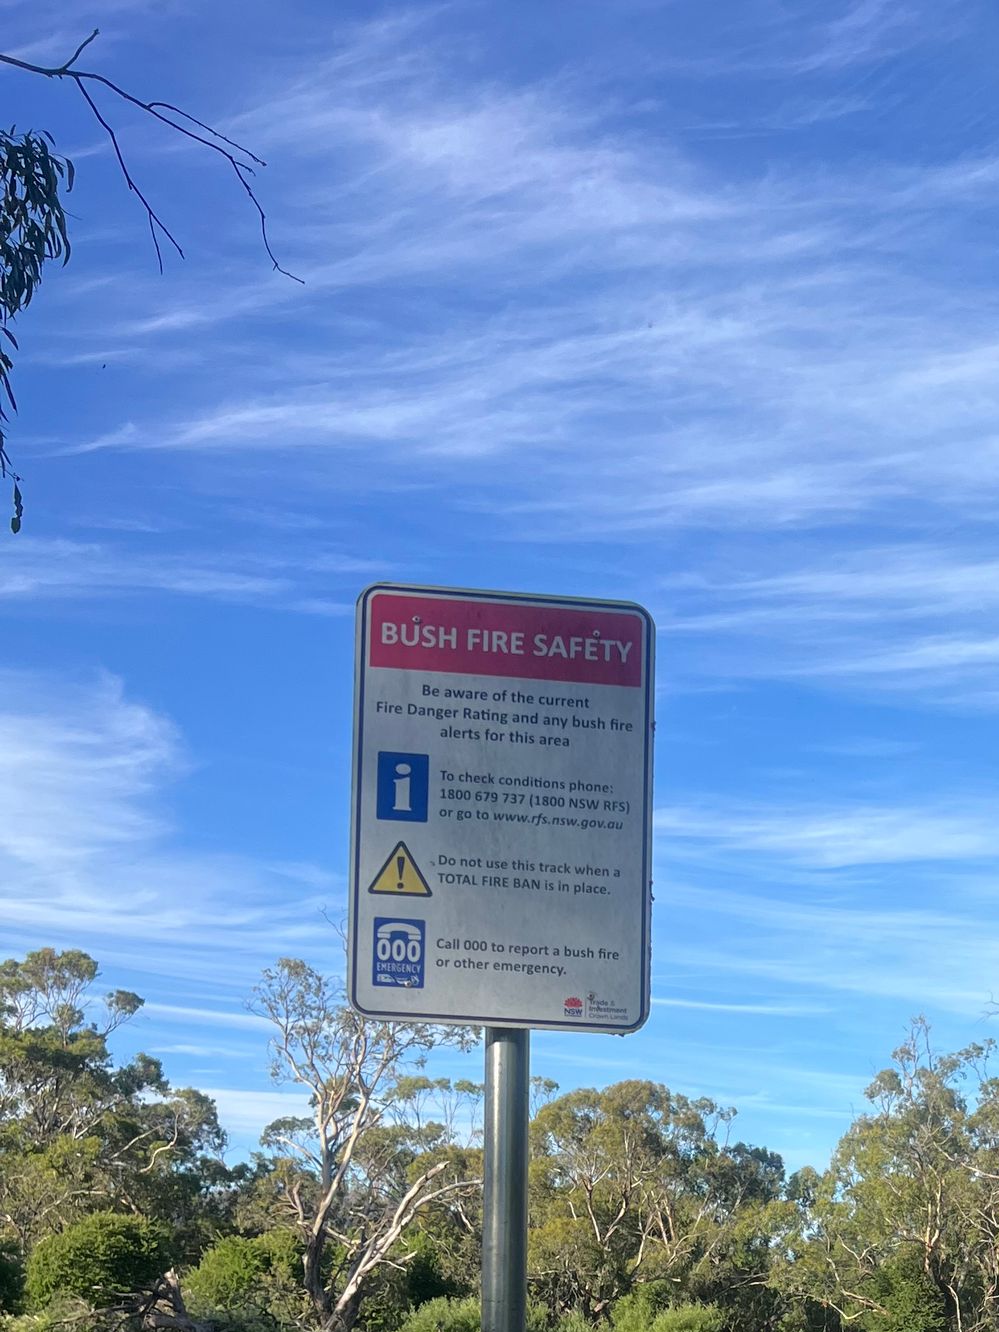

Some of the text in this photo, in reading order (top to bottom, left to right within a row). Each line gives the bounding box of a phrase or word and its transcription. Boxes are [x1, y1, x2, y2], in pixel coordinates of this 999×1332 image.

[381, 622, 632, 663] BUSH FIRE SAFETY
[422, 684, 590, 708] Be aware of the current
[376, 701, 633, 732] Fire Danger Rating and any bush fire
[440, 727, 570, 747] alerts for this area
[440, 771, 613, 794] To check conditions phone:
[440, 789, 630, 814] 1800 679 737 (1800 NSW RFS)
[440, 809, 623, 830] or go to www.rfs.nsw.gov.au
[438, 855, 620, 878] Do not use this track when a
[438, 873, 611, 895] TOTAL FIRE BAN is in place.
[377, 939, 421, 962] 000
[436, 939, 619, 960] Call 000 to report a bush fire
[377, 962, 421, 974] EMERGENCY
[436, 958, 566, 976] or other emergency.
